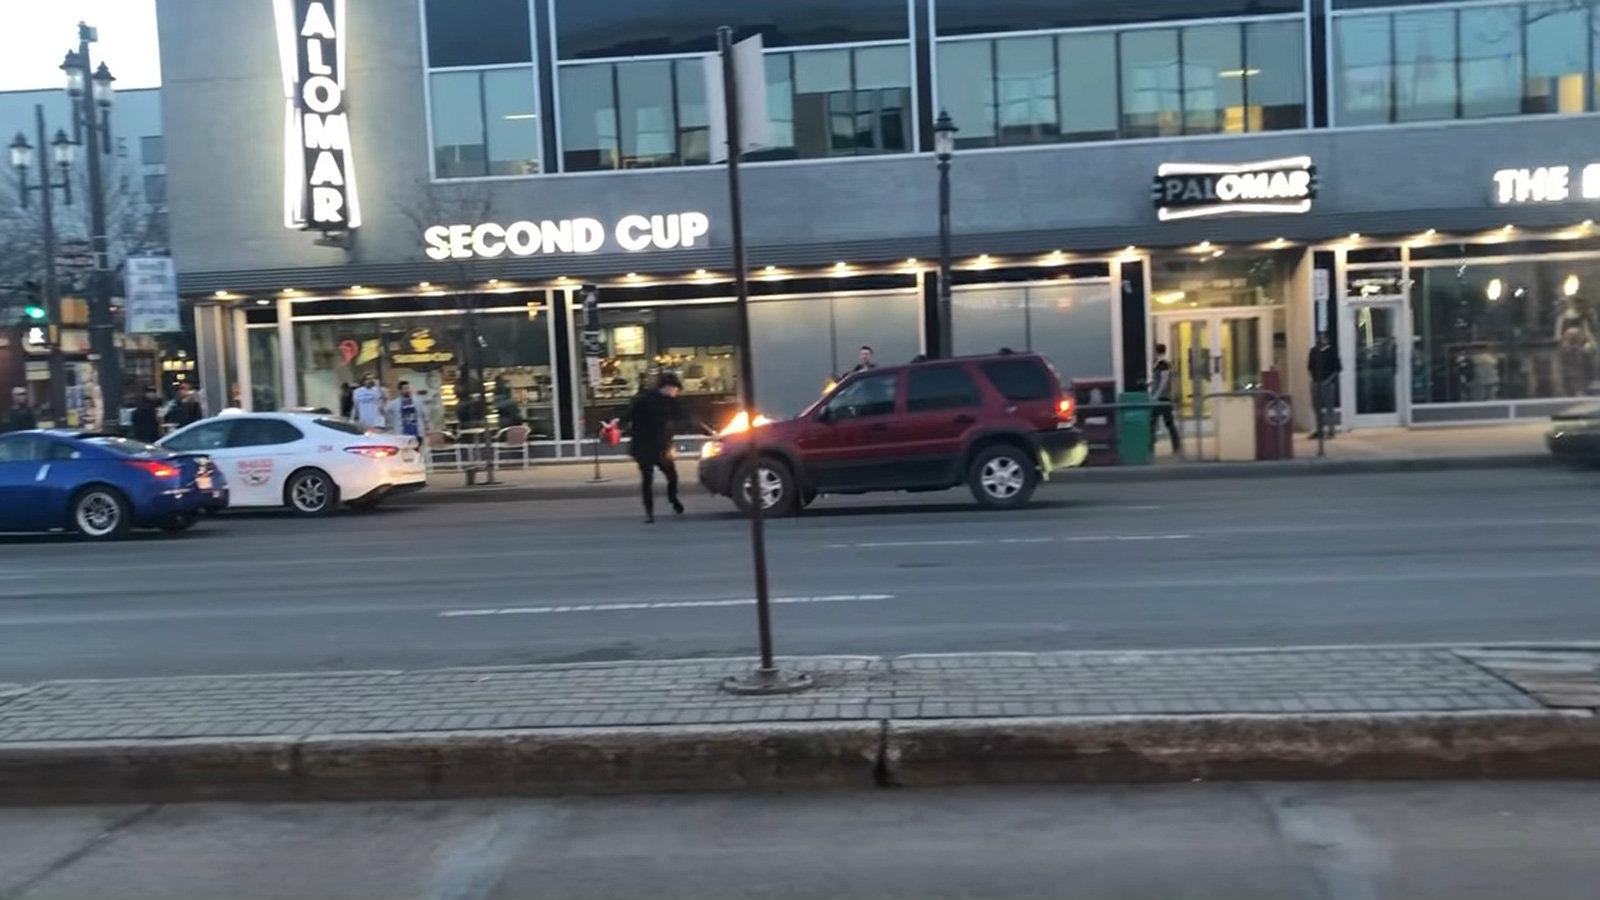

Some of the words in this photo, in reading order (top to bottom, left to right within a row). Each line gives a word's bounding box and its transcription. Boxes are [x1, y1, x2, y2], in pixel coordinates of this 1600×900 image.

[1165, 170, 1311, 201] PALOMAR
[1493, 165, 1569, 203] THE
[424, 218, 605, 260] SECOND
[615, 212, 709, 250] CUP
